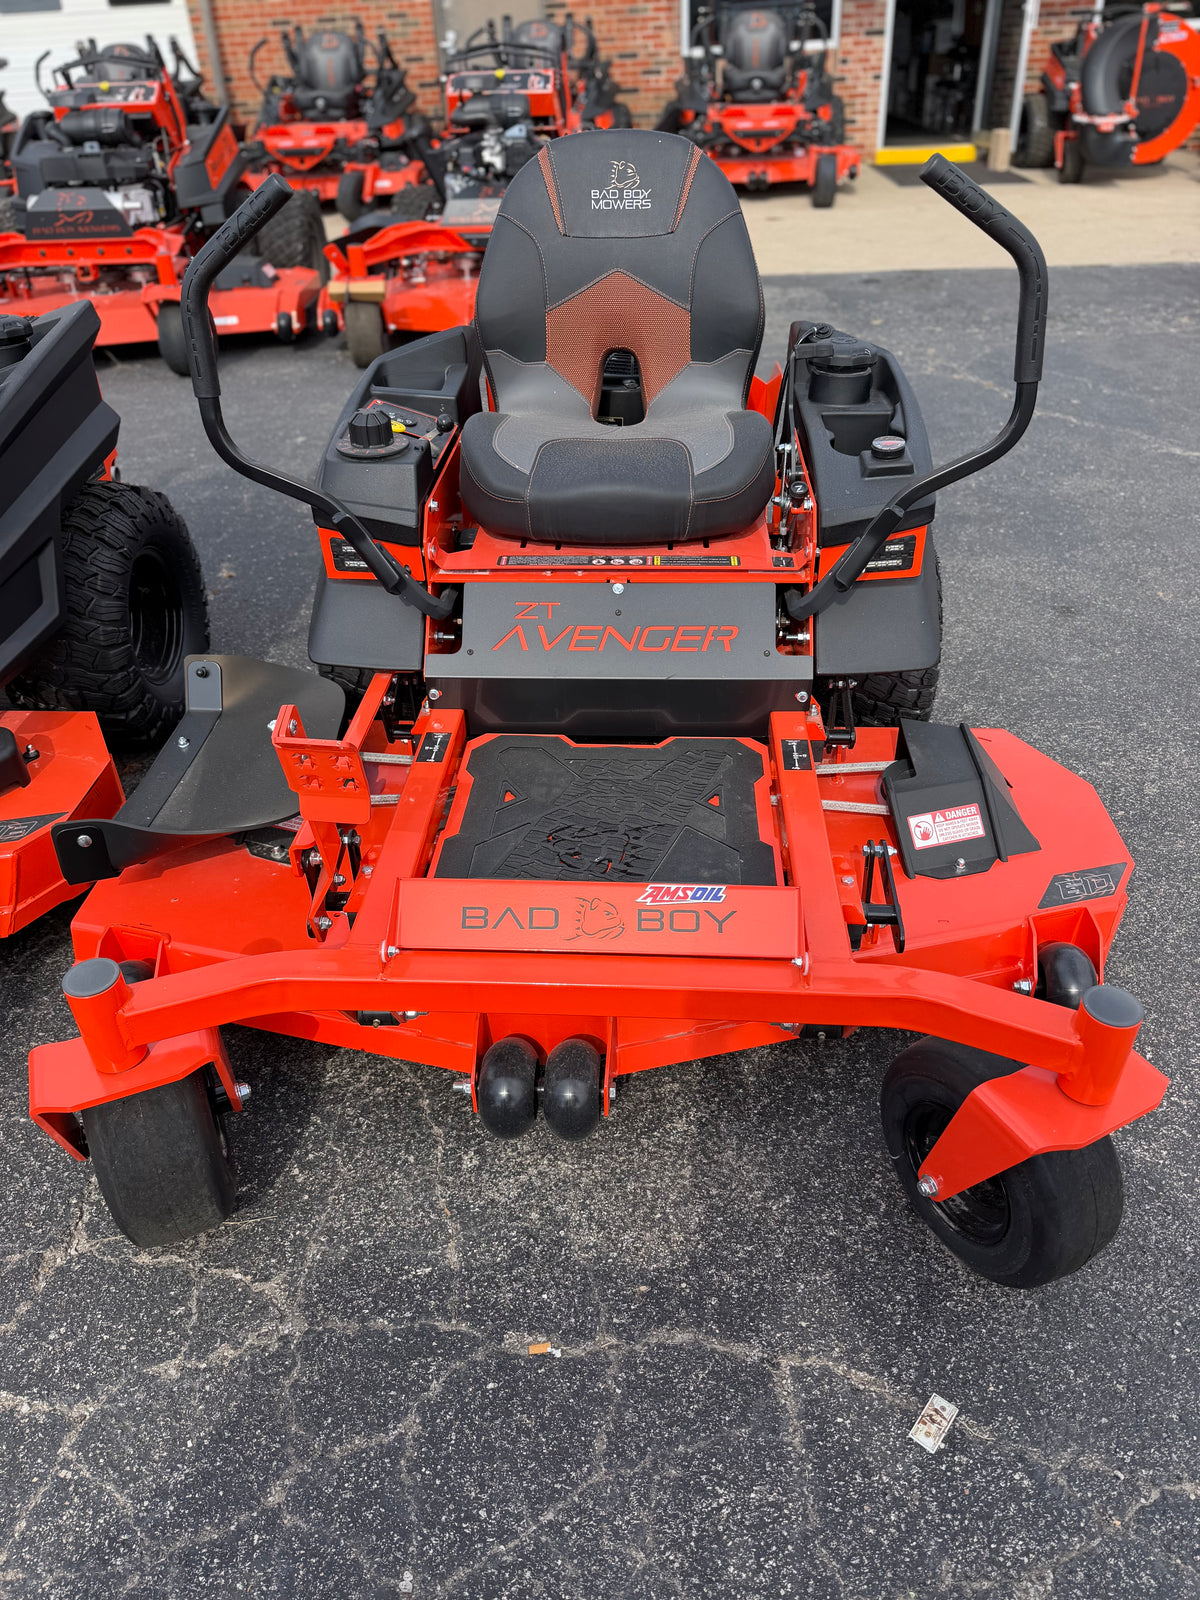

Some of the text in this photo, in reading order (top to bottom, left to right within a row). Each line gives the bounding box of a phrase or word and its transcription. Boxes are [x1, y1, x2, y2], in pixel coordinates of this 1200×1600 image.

[591, 188, 652, 199] BAD BOY
[591, 199, 652, 210] MOWERS
[514, 602, 561, 620] ZT
[491, 624, 739, 652] AVENGER
[945, 807, 978, 819] DANGER
[638, 885, 726, 904] AMSOIL
[461, 907, 738, 934] BAD BOY
